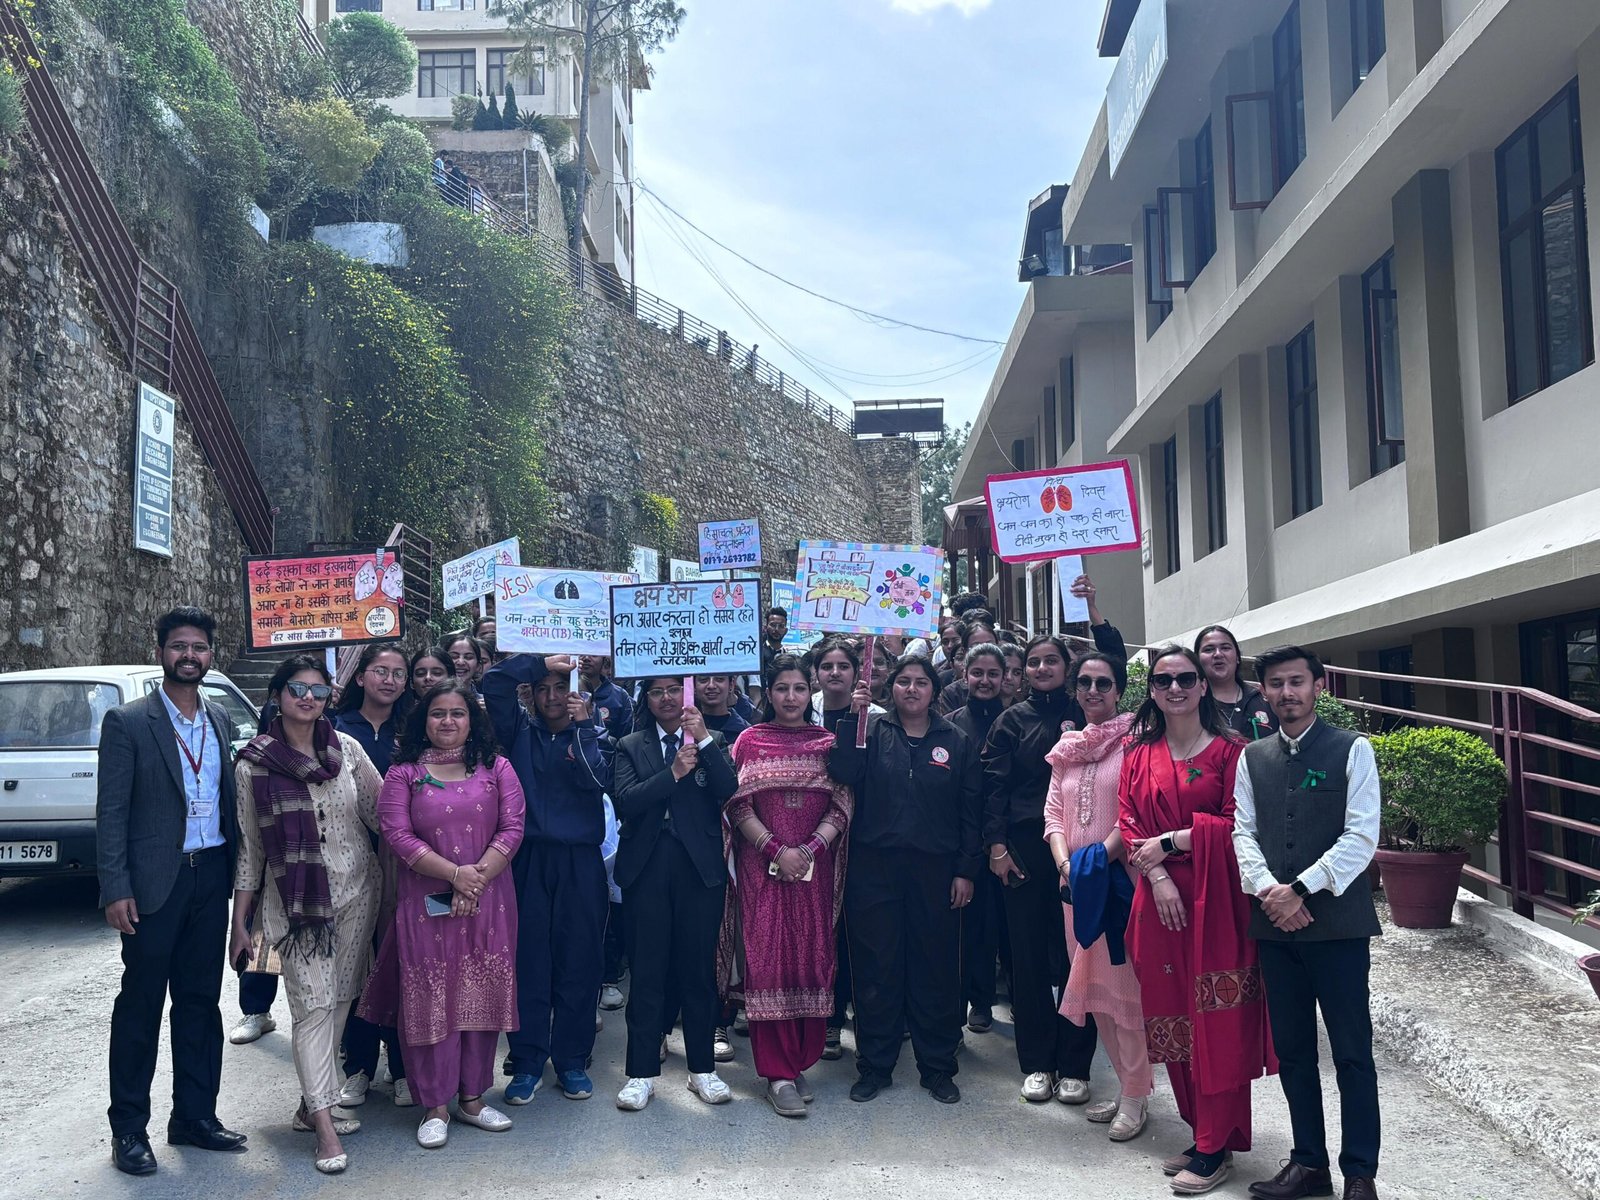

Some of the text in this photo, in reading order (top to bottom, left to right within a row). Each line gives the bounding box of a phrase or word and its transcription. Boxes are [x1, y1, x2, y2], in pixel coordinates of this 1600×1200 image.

[1135, 71, 1144, 109] OF
[1145, 34, 1159, 88] LAW
[145, 446, 168, 460] MECHANICAL
[148, 438, 167, 453] SCHOOL OF
[145, 454, 168, 471] ENGINEERING
[996, 484, 1107, 512] क्षयरोग दिवस
[145, 512, 159, 523] SCHOOL
[1038, 518, 1053, 529] का
[1055, 513, 1065, 529] हो
[1092, 507, 1102, 524] ही
[143, 528, 167, 542] ENGINEERING
[703, 522, 754, 540] हिमाचल प्रदेश
[1058, 531, 1068, 544] हो
[1093, 525, 1120, 541] हमारा
[703, 553, 757, 565] 0177-2673782
[255, 561, 271, 578] दर्द
[276, 564, 302, 577] इसका
[324, 558, 358, 576] दुखदायी
[255, 580, 271, 594] कई
[298, 579, 309, 590] ने
[312, 579, 330, 589] जान
[602, 574, 634, 583] WE CAN
[255, 591, 352, 611] अगर ना हो इसकी दवाई
[634, 584, 698, 608] क्षय रोग
[257, 607, 359, 629] समझो बीमारी वापिस आई
[567, 615, 581, 627] यह
[614, 604, 754, 628] का अगर करना हो समय रहते
[305, 629, 327, 640] कीमती
[551, 627, 571, 639] (TB)
[573, 626, 583, 639] को
[585, 629, 598, 641] दूर
[669, 628, 692, 638] इलाज
[615, 638, 636, 657] तीन
[660, 636, 668, 655] से
[669, 637, 700, 656] अधिक
[701, 636, 723, 656] खांसी
[723, 641, 735, 655] न
[737, 635, 758, 655] करे
[21, 845, 53, 859] 5678
